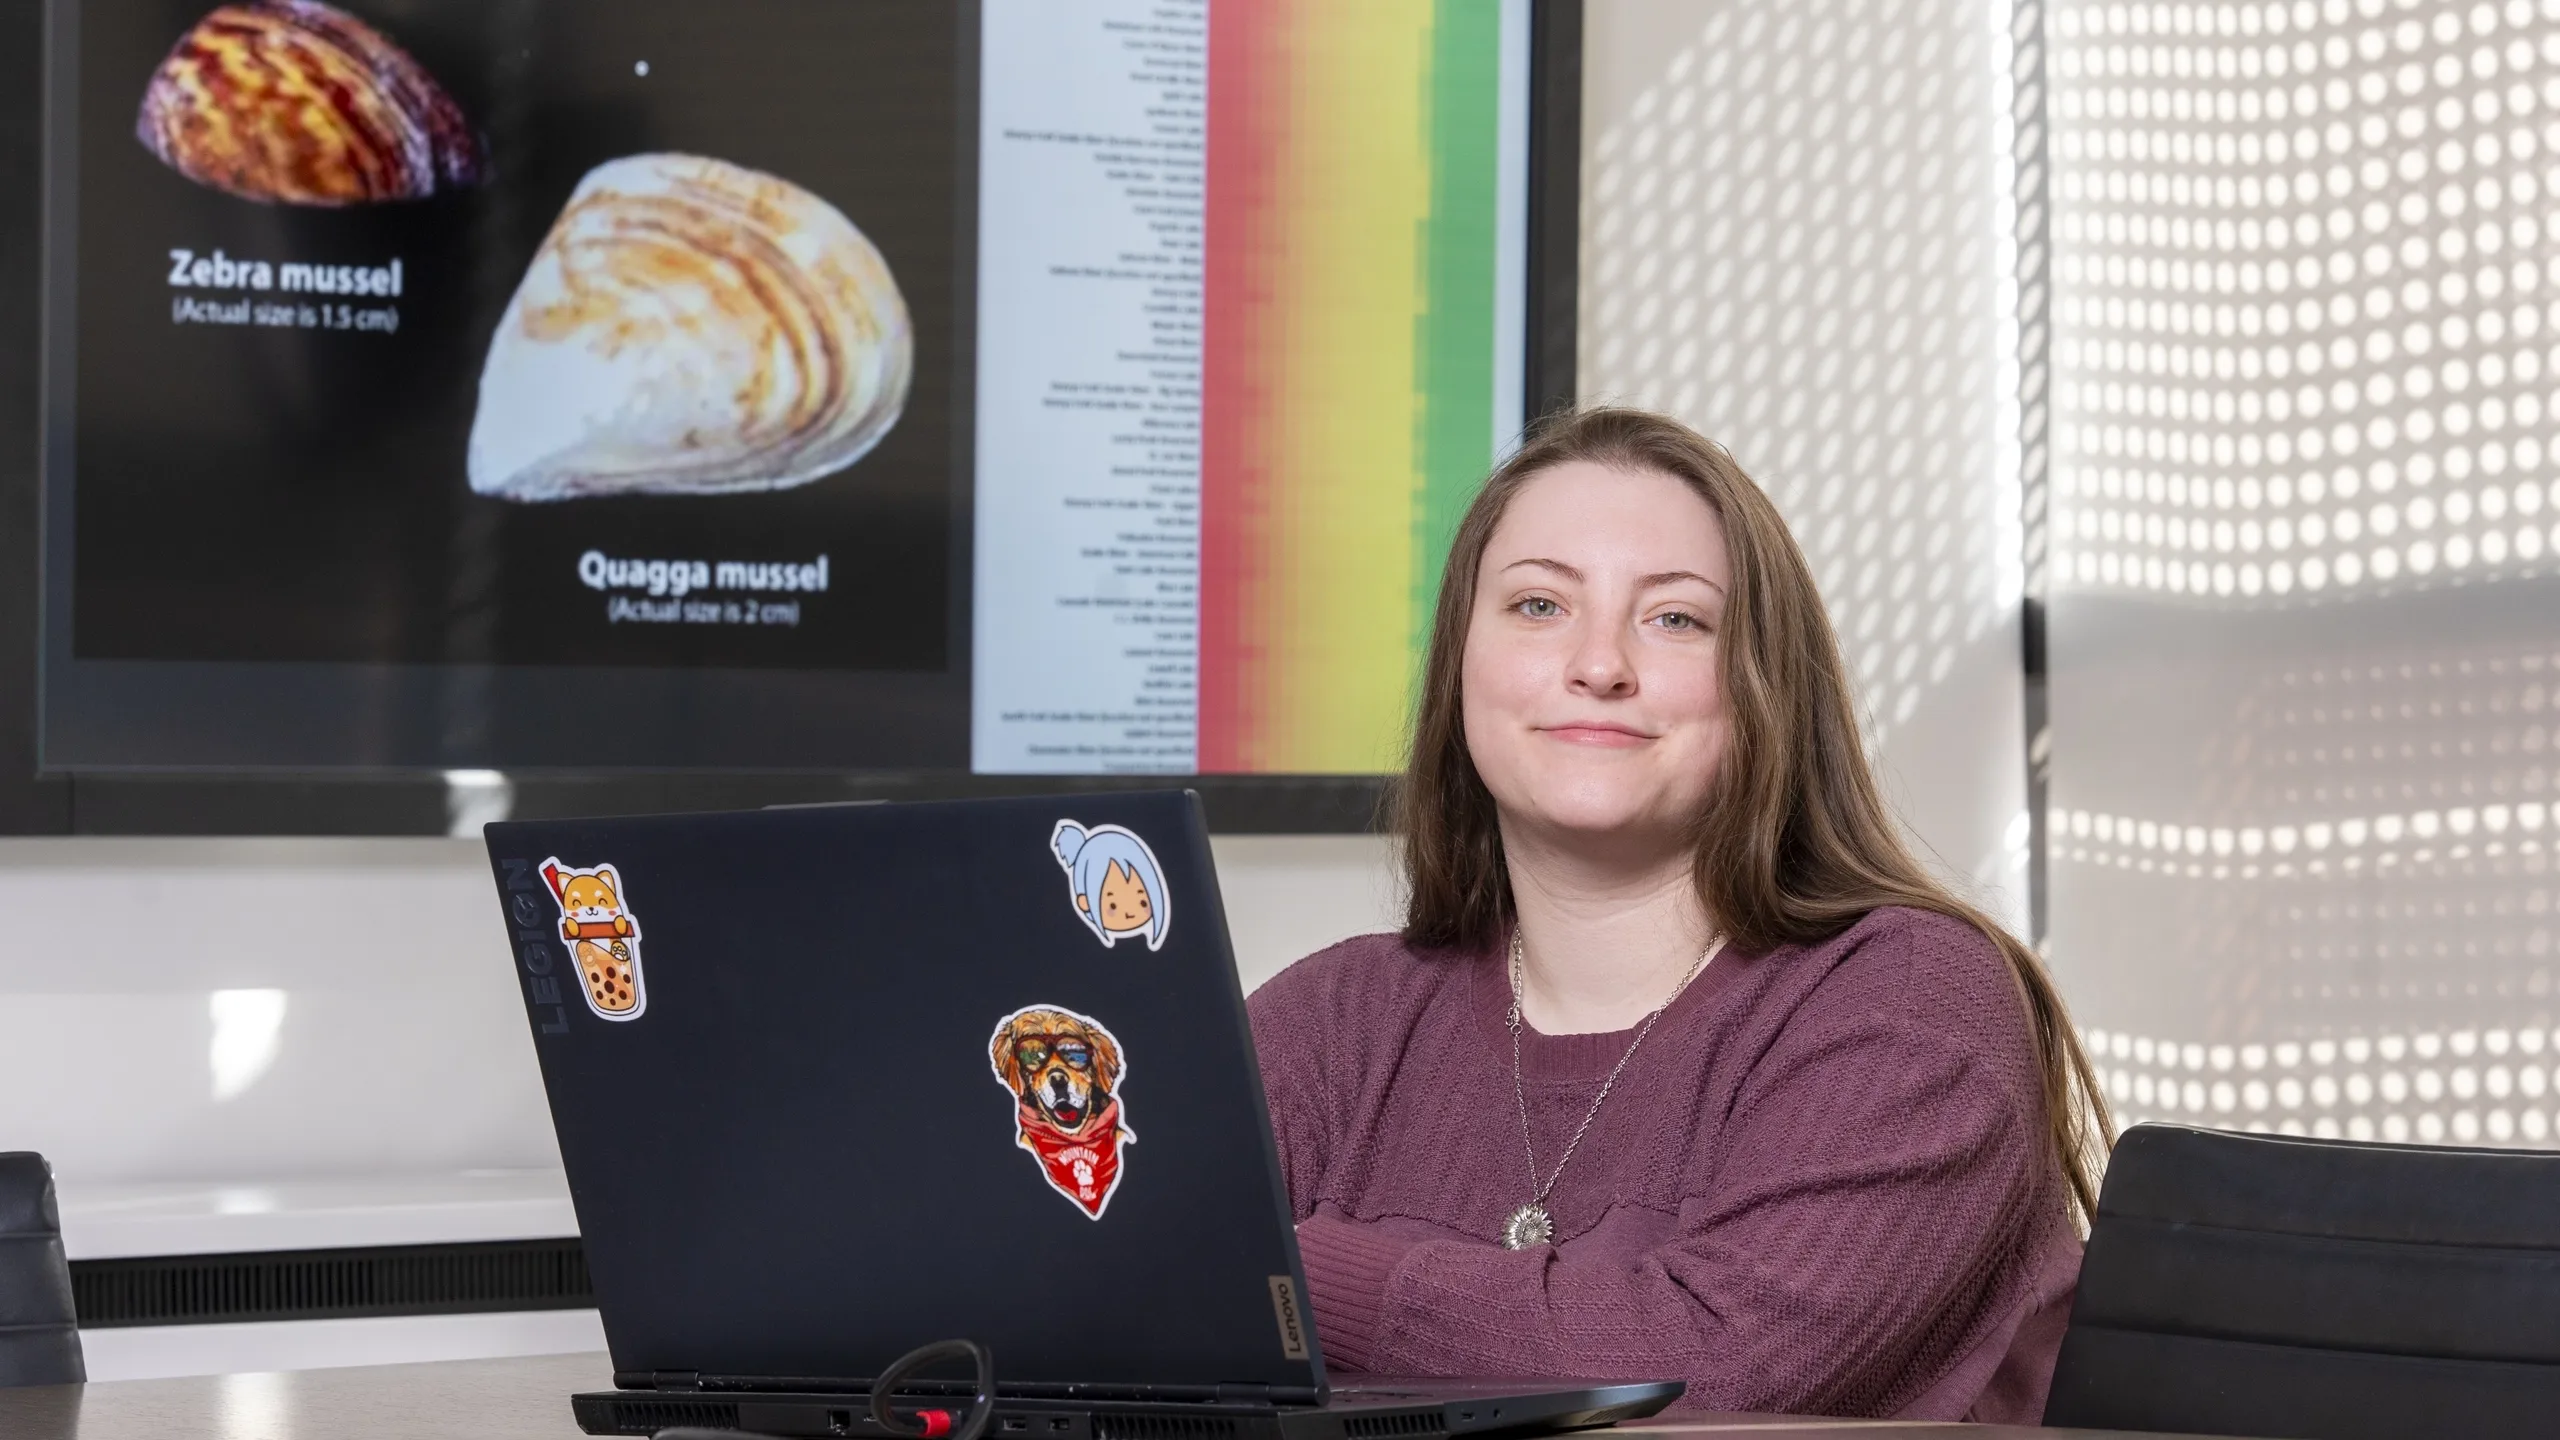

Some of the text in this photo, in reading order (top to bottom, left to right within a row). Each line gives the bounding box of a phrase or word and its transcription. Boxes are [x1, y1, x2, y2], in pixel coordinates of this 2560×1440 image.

[169, 249, 402, 296] Zebra mussel
[172, 297, 399, 335] (Actual size is 1.5 cm)
[578, 550, 828, 596] Quagga mussel
[608, 596, 800, 627] (Actual size is 2 cm)
[501, 858, 570, 1035] LEGION
[1278, 1283, 1302, 1353] Lenovo
